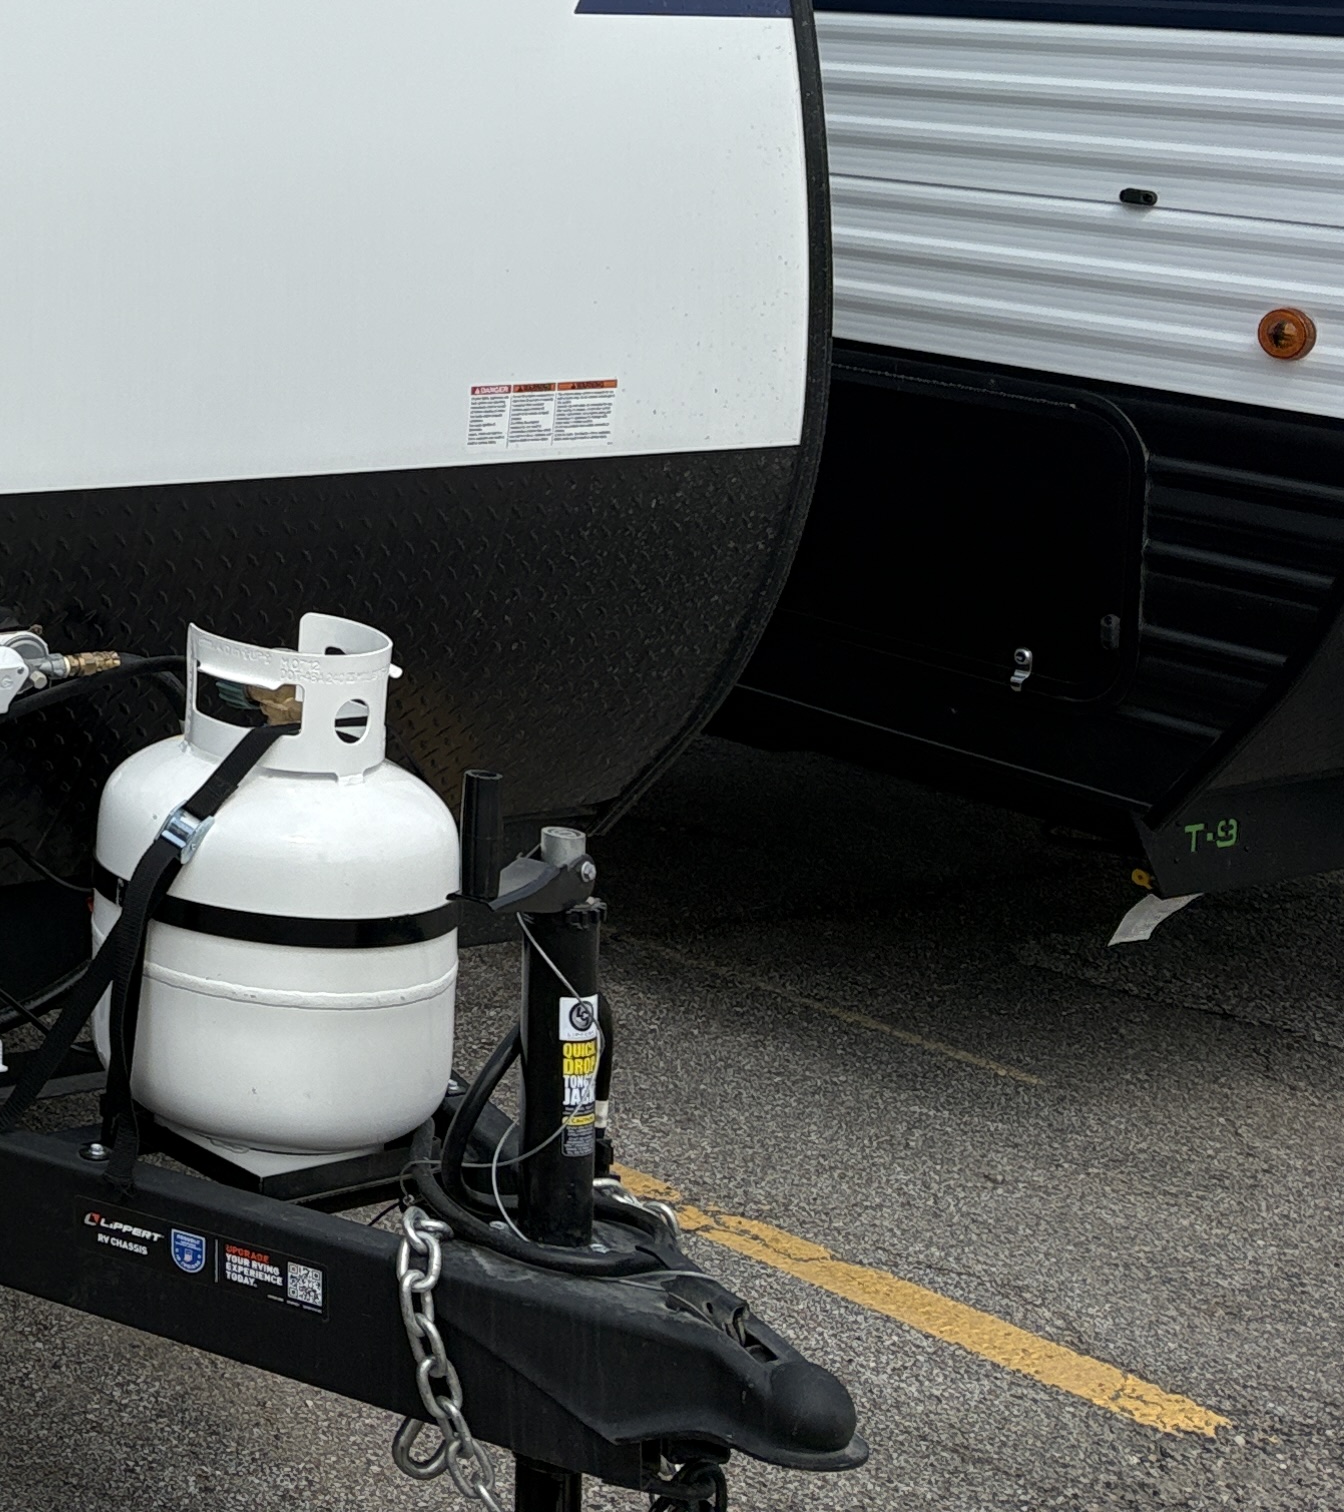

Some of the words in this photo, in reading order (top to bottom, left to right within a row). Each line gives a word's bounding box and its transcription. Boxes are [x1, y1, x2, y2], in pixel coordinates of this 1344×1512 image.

[1184, 818, 1239, 852] T-9
[100, 1218, 161, 1242] LIPPERT
[97, 1233, 110, 1244] RV
[110, 1237, 149, 1256] CHASSIS
[226, 1244, 270, 1263] UPGRADE
[225, 1253, 250, 1267] YOUR
[251, 1260, 280, 1276] RVING
[225, 1262, 283, 1286] EXPERIENCE
[225, 1271, 258, 1288] TODAY.
